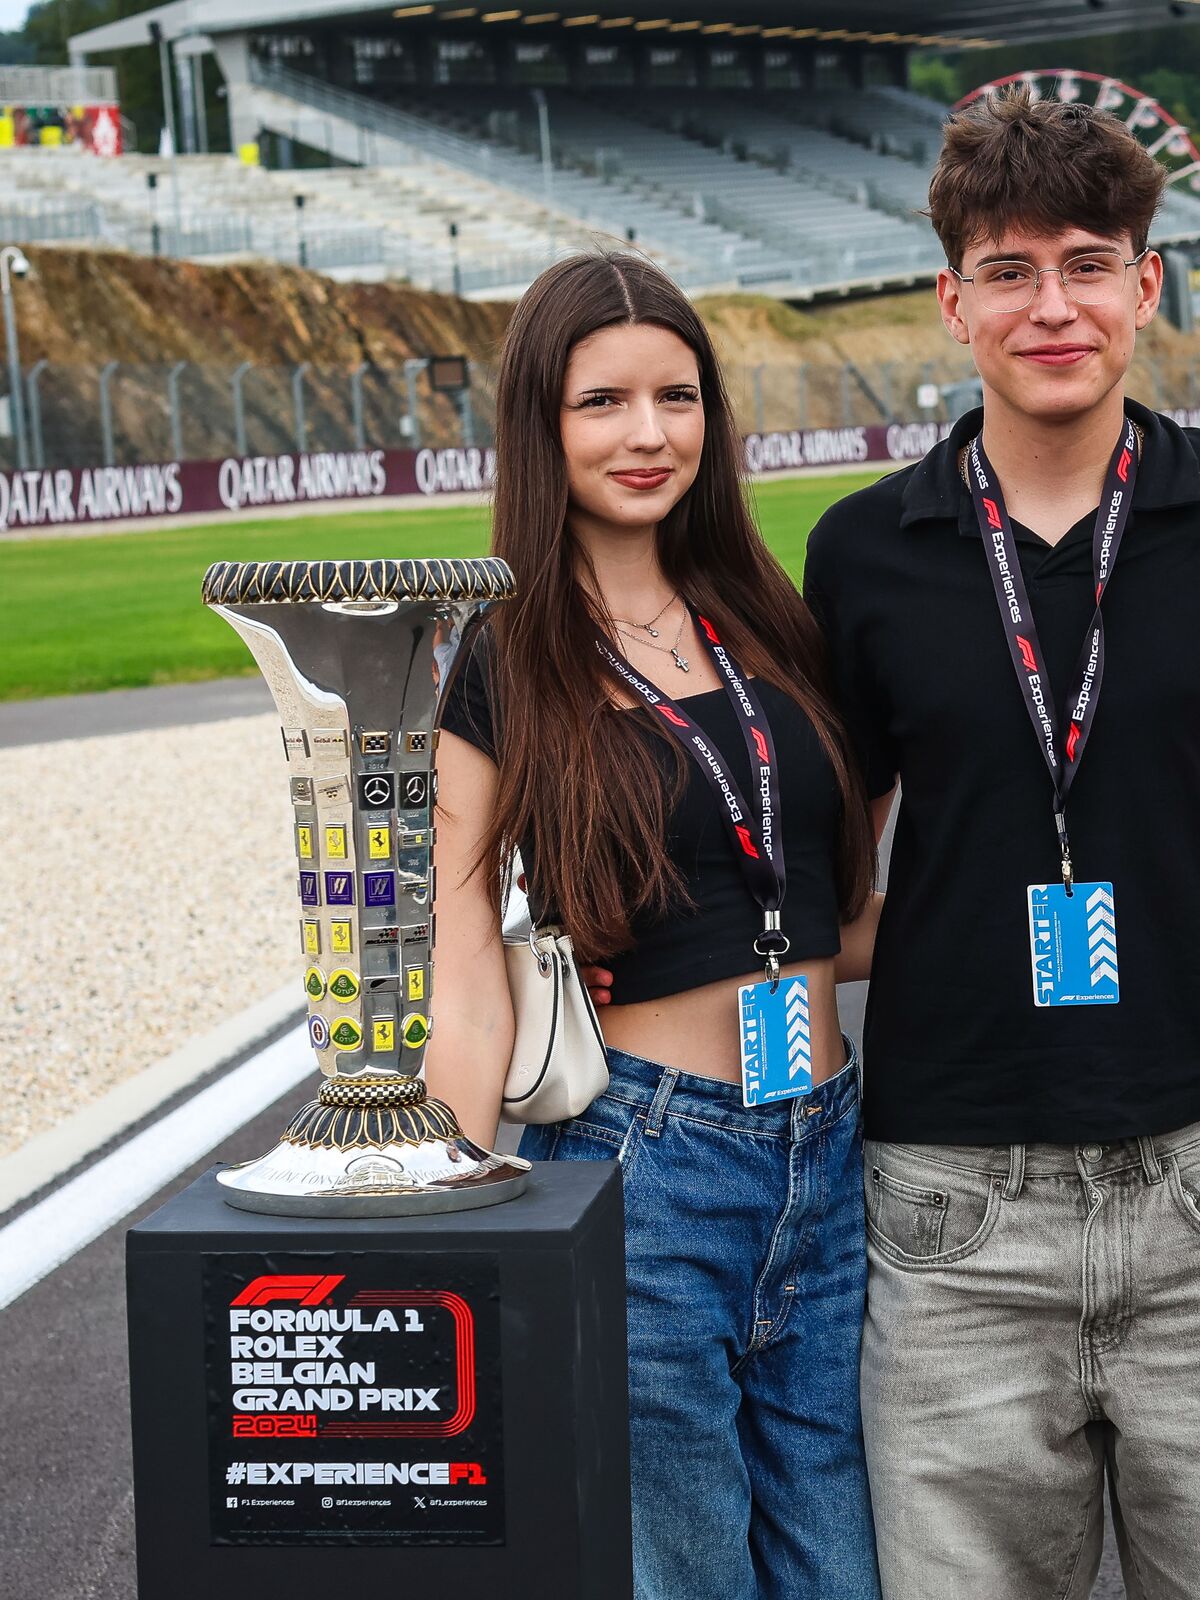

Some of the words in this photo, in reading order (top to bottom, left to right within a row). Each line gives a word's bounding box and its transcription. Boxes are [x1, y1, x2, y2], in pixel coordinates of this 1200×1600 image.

[77, 462, 183, 520] AIRWAYS
[218, 454, 296, 512] QATAR
[298, 449, 387, 500] AIRWAYS
[415, 447, 484, 496] QATAR
[1099, 490, 1123, 579] Experiences
[991, 531, 1023, 624] Experiences
[713, 645, 756, 718] Experiences
[1071, 628, 1100, 722] Experiences
[1027, 673, 1058, 767] Experiences
[691, 735, 744, 823] Experiences
[1032, 888, 1054, 1005] STARTER
[742, 987, 760, 1105] STARTER
[229, 1274, 346, 1306] F1
[229, 1309, 400, 1332] FORMULA
[405, 1309, 424, 1332] 1
[230, 1335, 345, 1359] ROLEX
[231, 1361, 376, 1385] BELGIAN
[232, 1388, 354, 1411] GRAND
[358, 1388, 441, 1411] PRIX
[232, 1414, 318, 1438] 2024
[226, 1462, 487, 1485] #EXPERIENCEF1
[251, 1499, 295, 1508] Experiences
